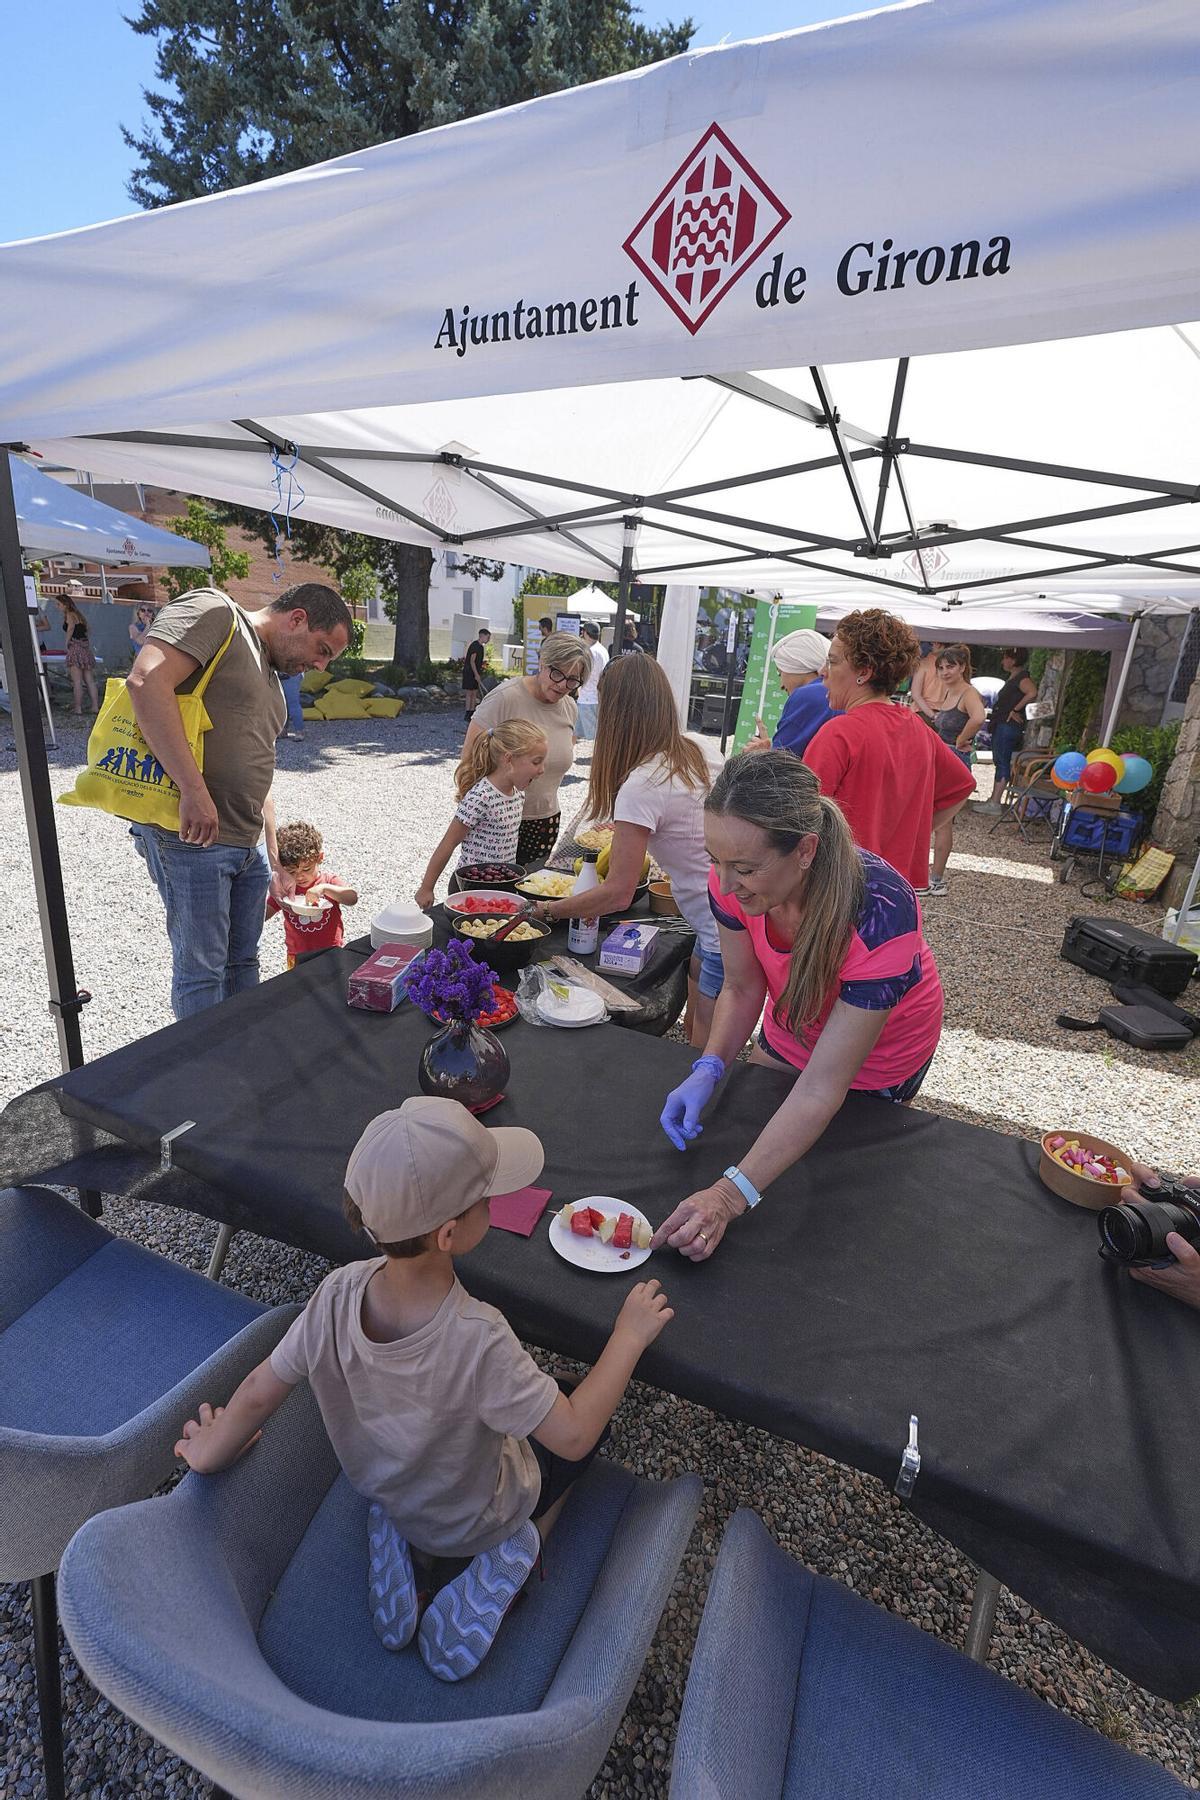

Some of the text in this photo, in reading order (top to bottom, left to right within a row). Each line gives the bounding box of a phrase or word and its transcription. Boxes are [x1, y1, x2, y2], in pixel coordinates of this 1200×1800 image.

[434, 235, 1011, 357] Ajuntament de Girona
